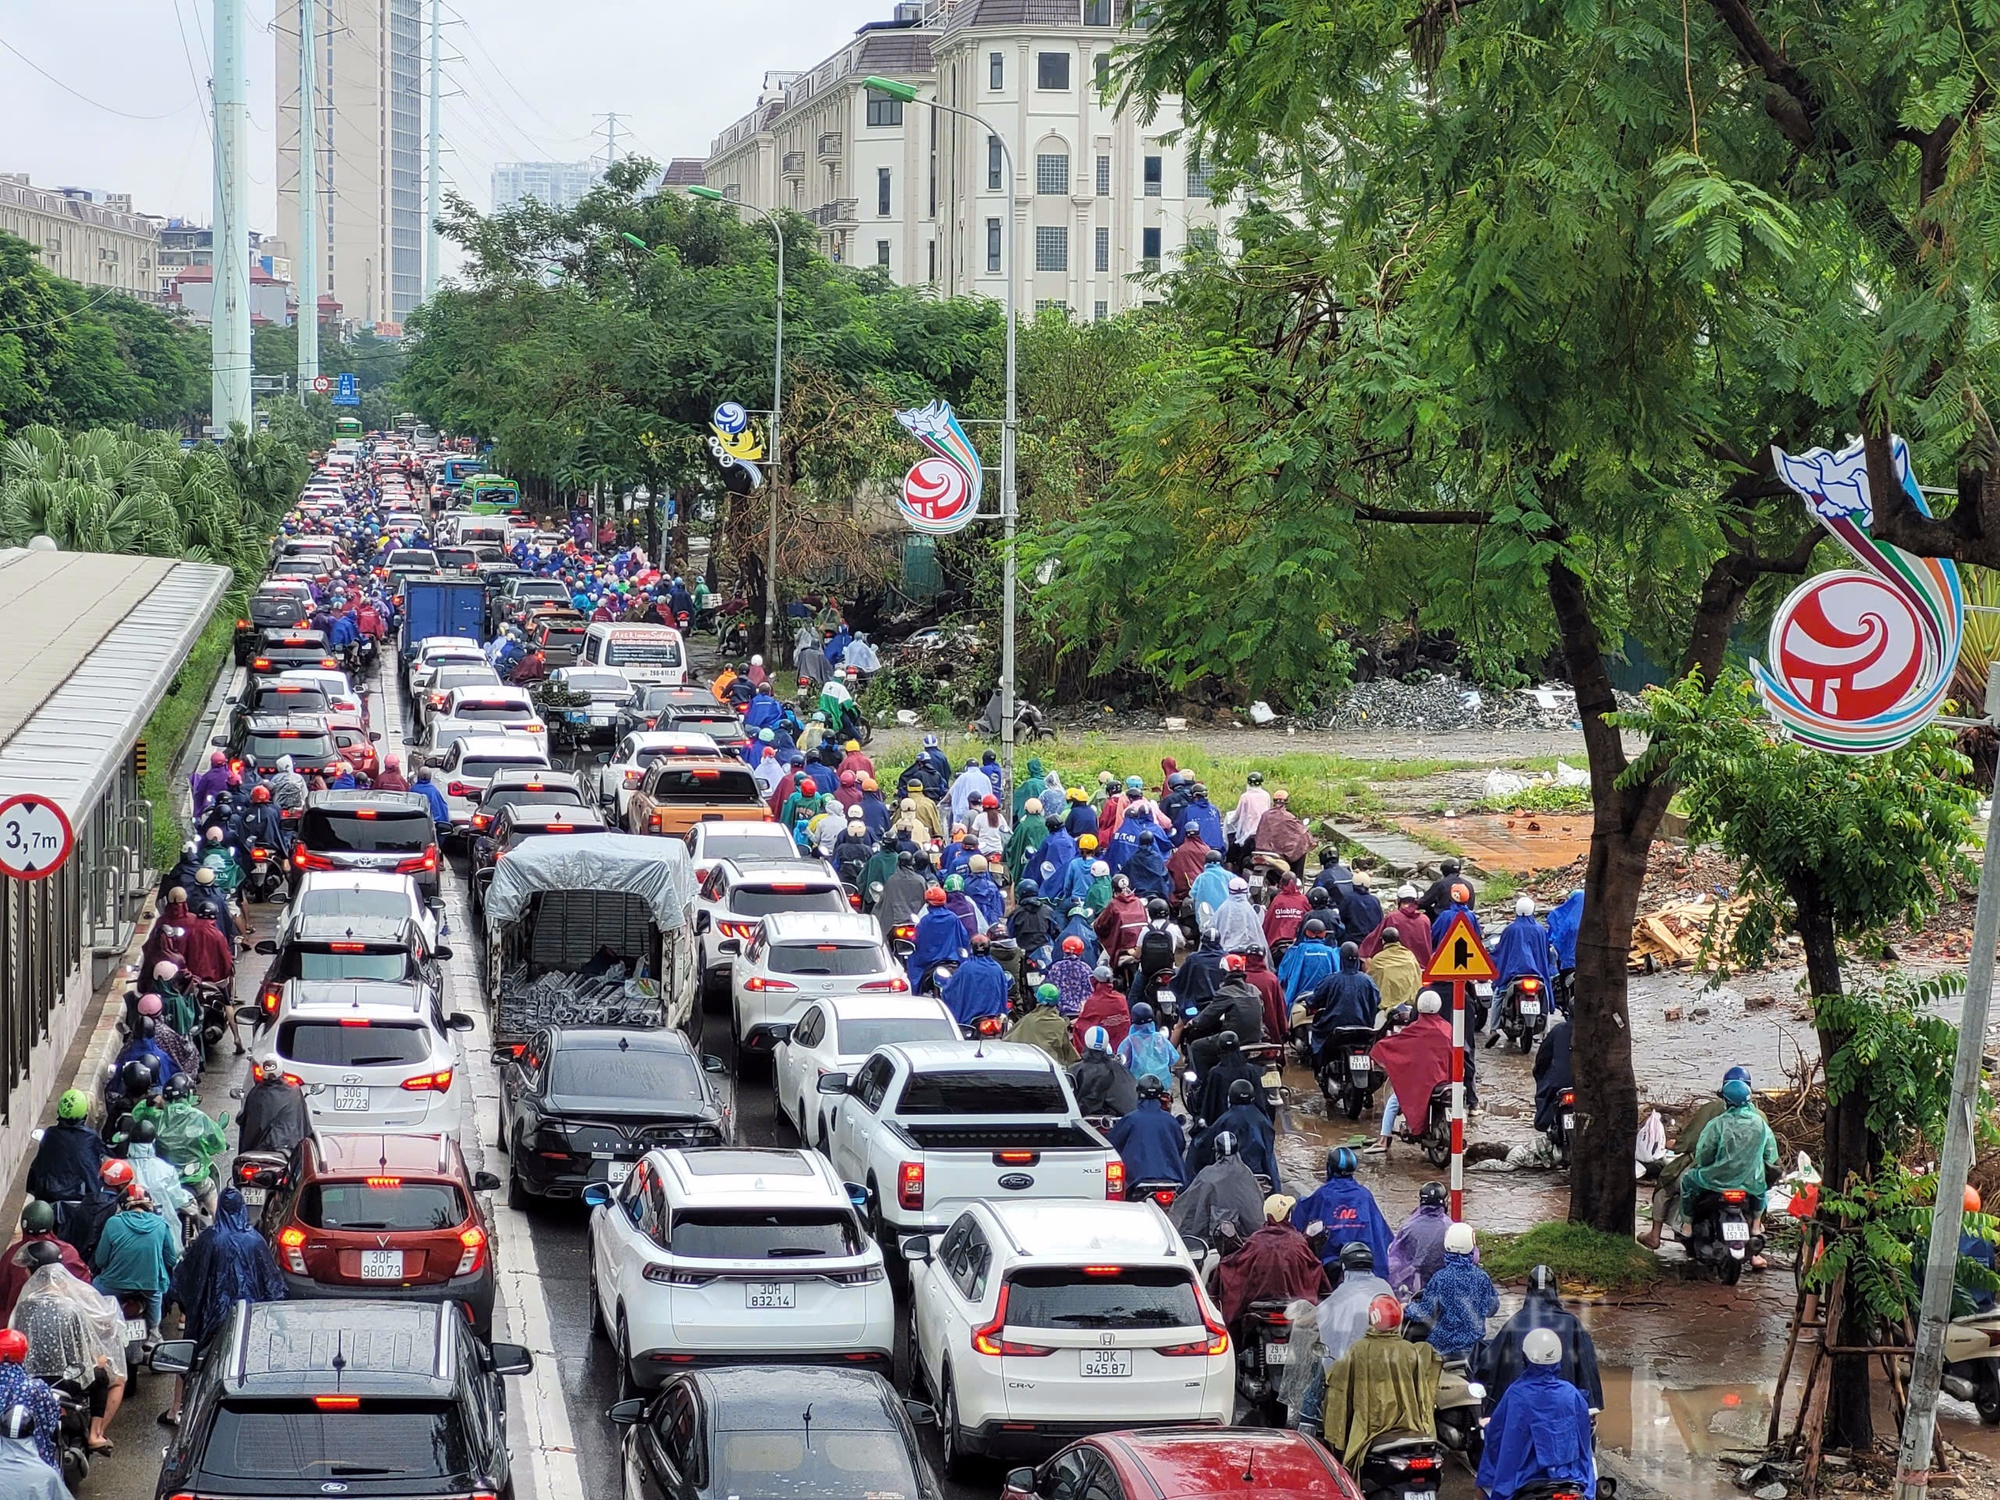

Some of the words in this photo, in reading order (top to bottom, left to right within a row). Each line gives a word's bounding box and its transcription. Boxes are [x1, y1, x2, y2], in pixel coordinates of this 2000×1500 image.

[5, 820, 57, 855] 3,7m
[342, 1087, 362, 1098] 30G
[336, 1098, 368, 1109] 077.23
[371, 1252, 392, 1264] 30F
[362, 1264, 401, 1277] 980.73
[759, 1284, 781, 1295] 30H
[750, 1296, 790, 1307] 832.14
[1094, 1352, 1117, 1363] 30K
[1086, 1364, 1126, 1375] 945.87
